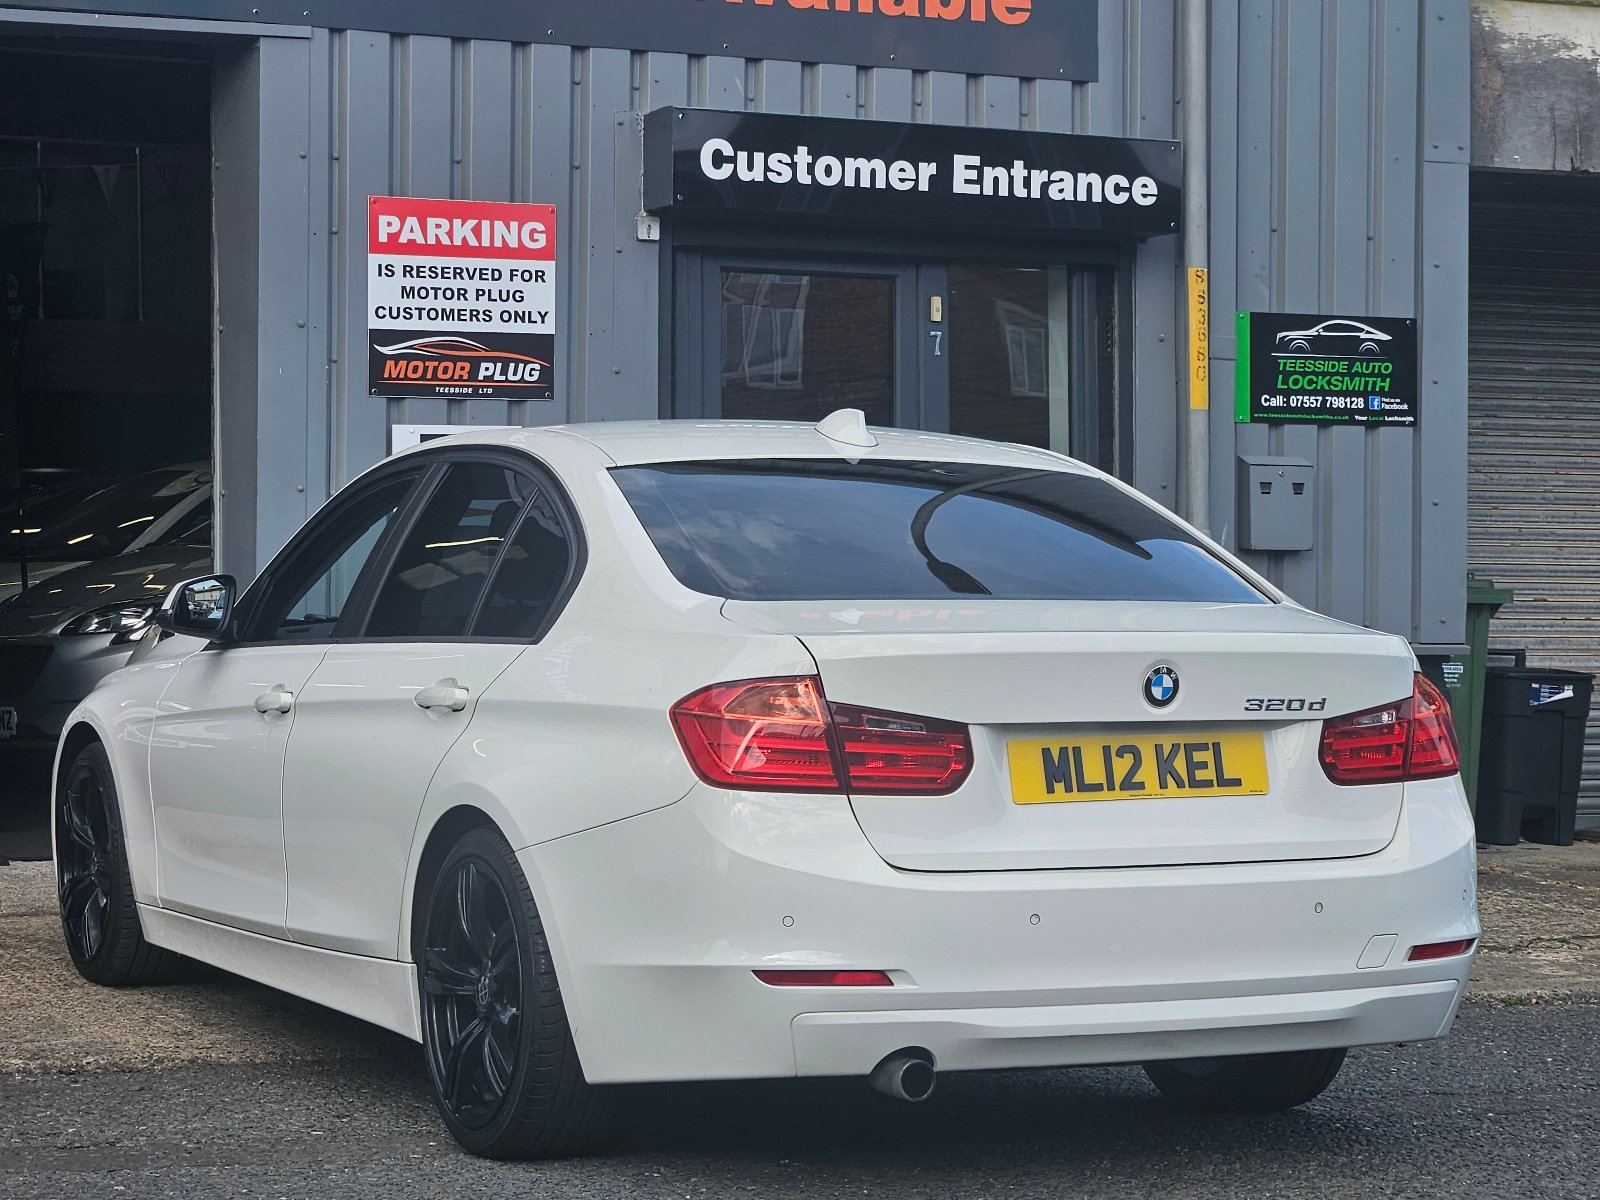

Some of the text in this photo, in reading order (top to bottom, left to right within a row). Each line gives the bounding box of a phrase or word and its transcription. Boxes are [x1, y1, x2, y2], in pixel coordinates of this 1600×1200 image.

[700, 138, 1158, 206] Customer Entrance
[378, 215, 547, 249] PARKING
[377, 263, 546, 283] IS RESERVED FOR
[400, 286, 525, 303] MOTOR PLUG
[374, 305, 549, 324] CUSTOMERS ONLY
[929, 331, 943, 356] 7
[383, 359, 541, 382] MOTOR PLUG
[1277, 359, 1393, 374] TEESSIDE AUTO
[435, 386, 473, 394] TEESSIDE
[1276, 375, 1391, 392] LOCKSMITH
[1260, 394, 1365, 409] Call: 07557 798128
[1381, 402, 1409, 410] Facebook
[1243, 697, 1327, 712] 320d
[1041, 741, 1243, 794] ML12 KEL
